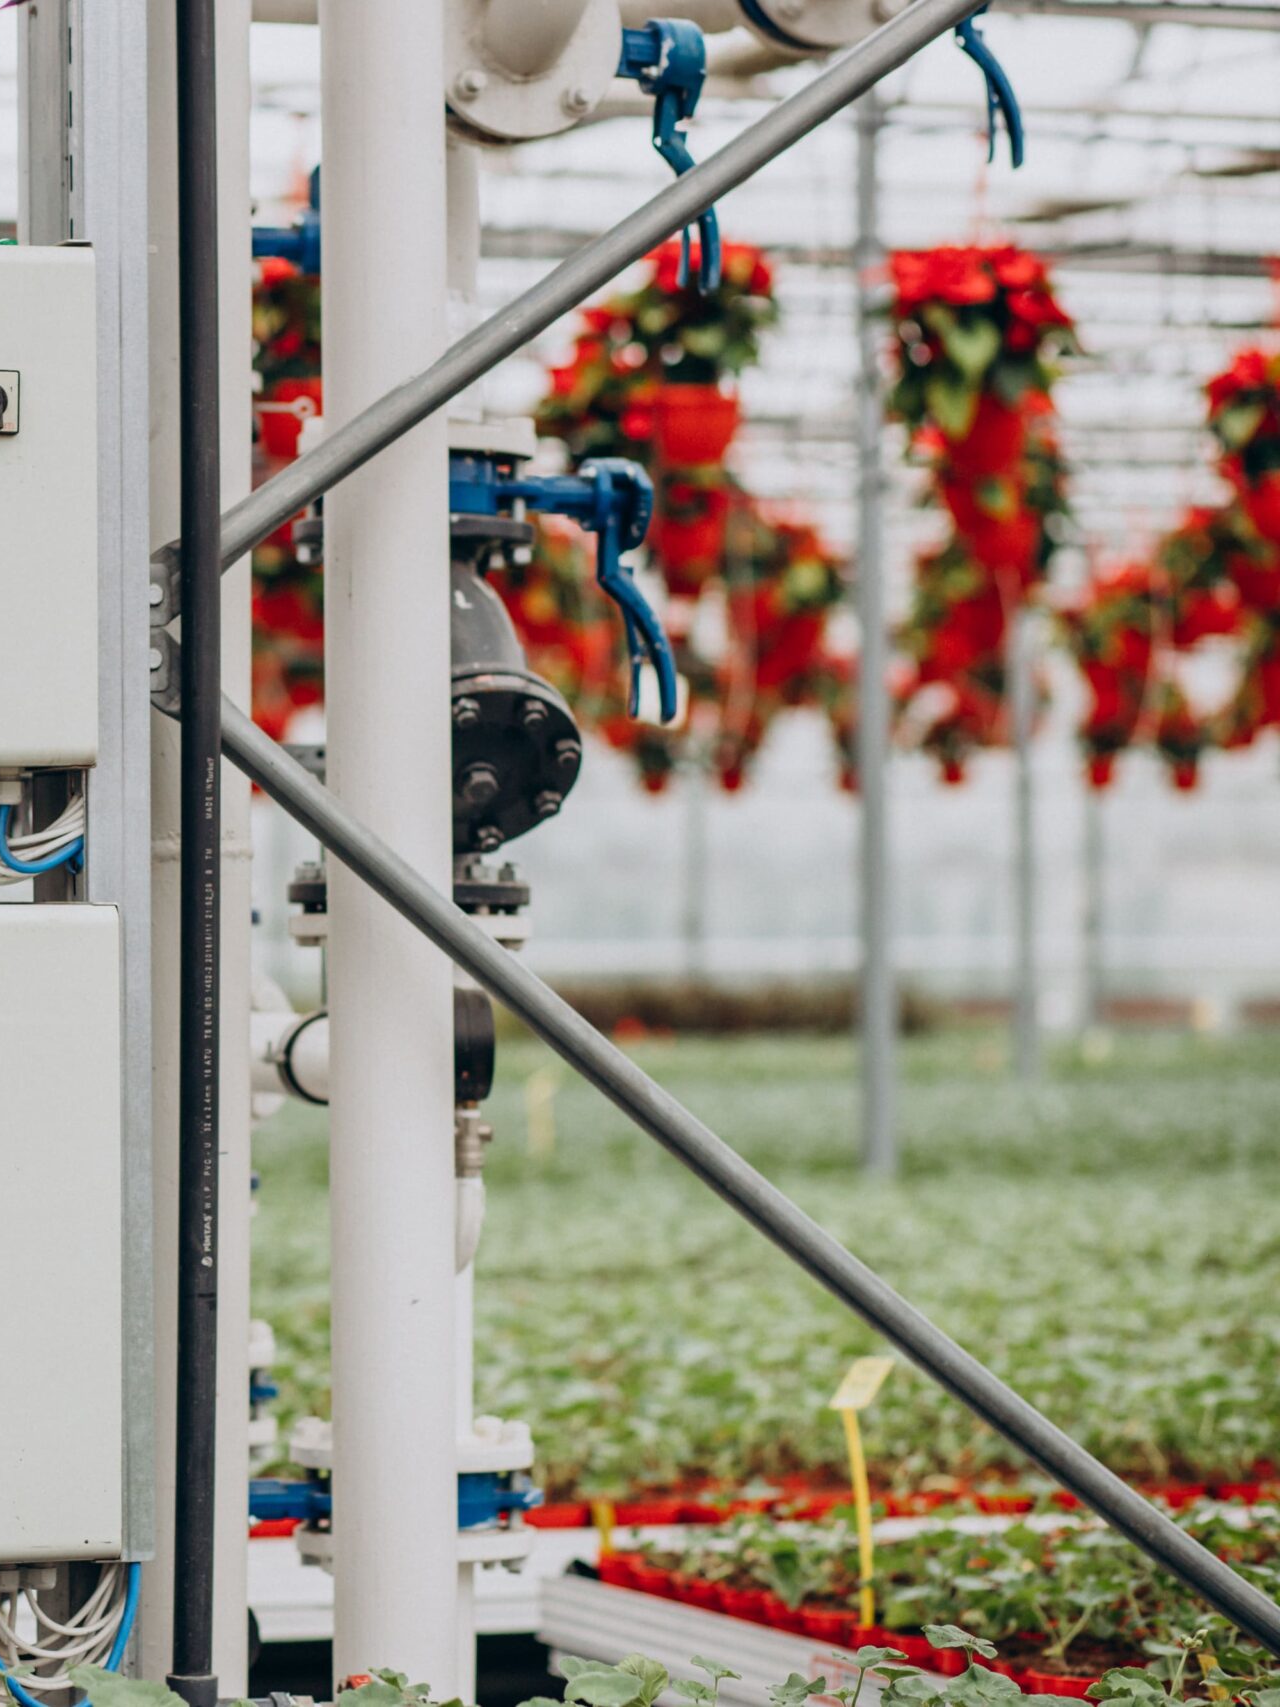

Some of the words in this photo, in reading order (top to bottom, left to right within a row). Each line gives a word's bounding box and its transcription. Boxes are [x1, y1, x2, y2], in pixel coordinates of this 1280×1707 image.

[205, 796, 213, 819] MADE
[204, 996, 212, 1011] ISO
[204, 1015, 212, 1026] EN
[204, 1159, 212, 1176] PVC
